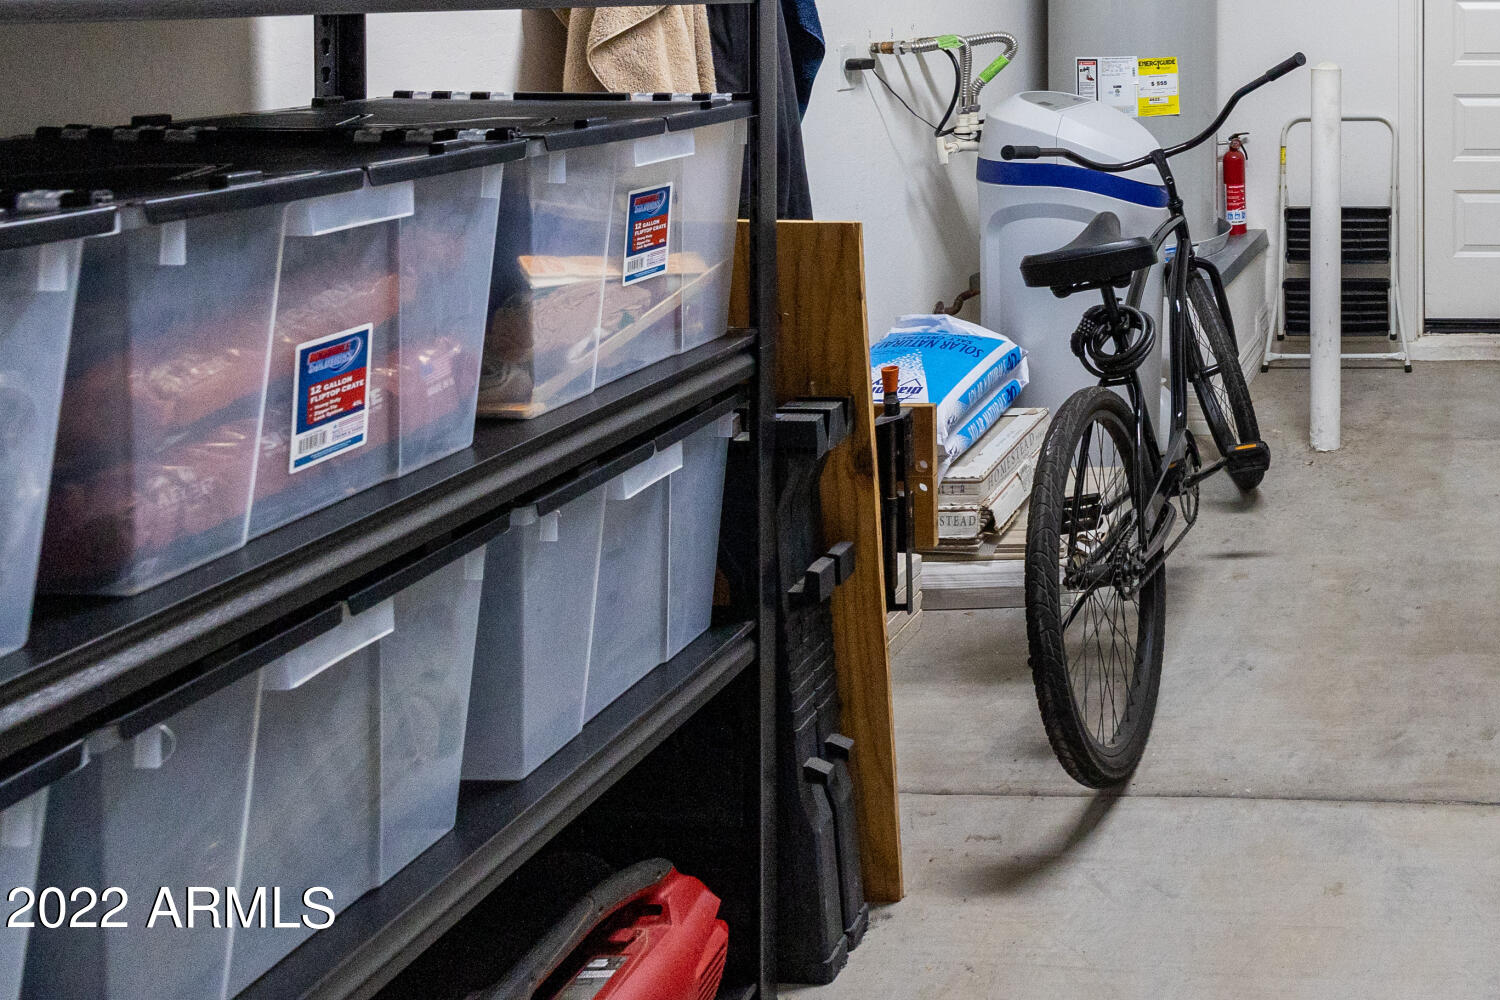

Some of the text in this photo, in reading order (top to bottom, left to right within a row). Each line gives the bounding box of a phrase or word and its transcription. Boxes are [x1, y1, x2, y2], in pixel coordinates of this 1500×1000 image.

[939, 339, 984, 358] SOLAR
[310, 375, 353, 395] 12 GALLON
[310, 379, 365, 404] FLIPTOP CRATE
[988, 433, 1035, 490] HOMESTEAD
